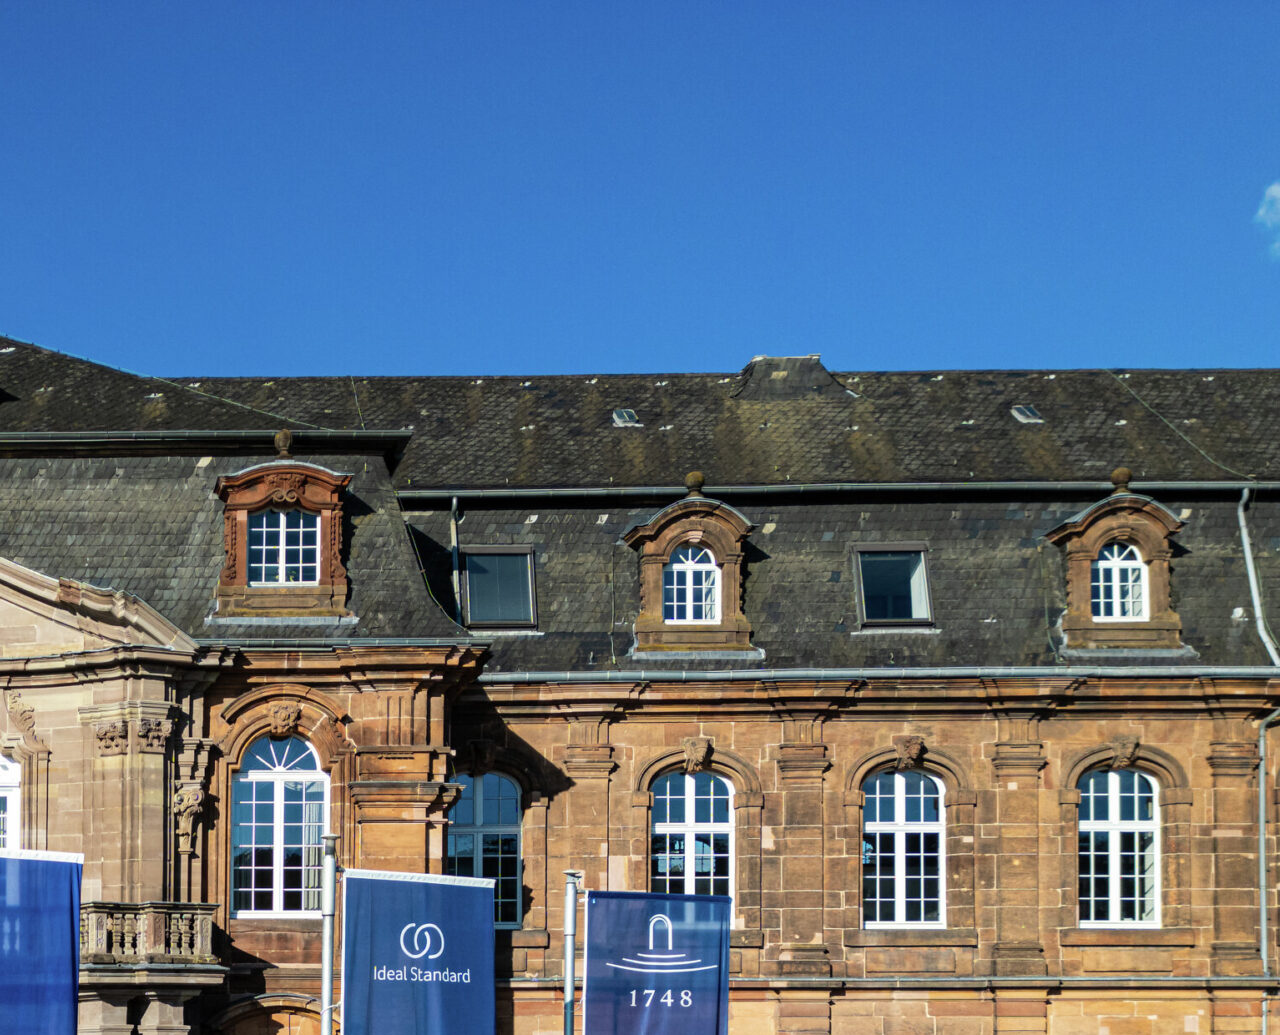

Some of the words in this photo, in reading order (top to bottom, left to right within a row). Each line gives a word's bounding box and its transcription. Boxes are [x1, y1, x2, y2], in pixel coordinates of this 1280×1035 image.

[372, 965, 408, 982] Ideal
[410, 966, 472, 984] Standard
[628, 989, 693, 1008] 1748
